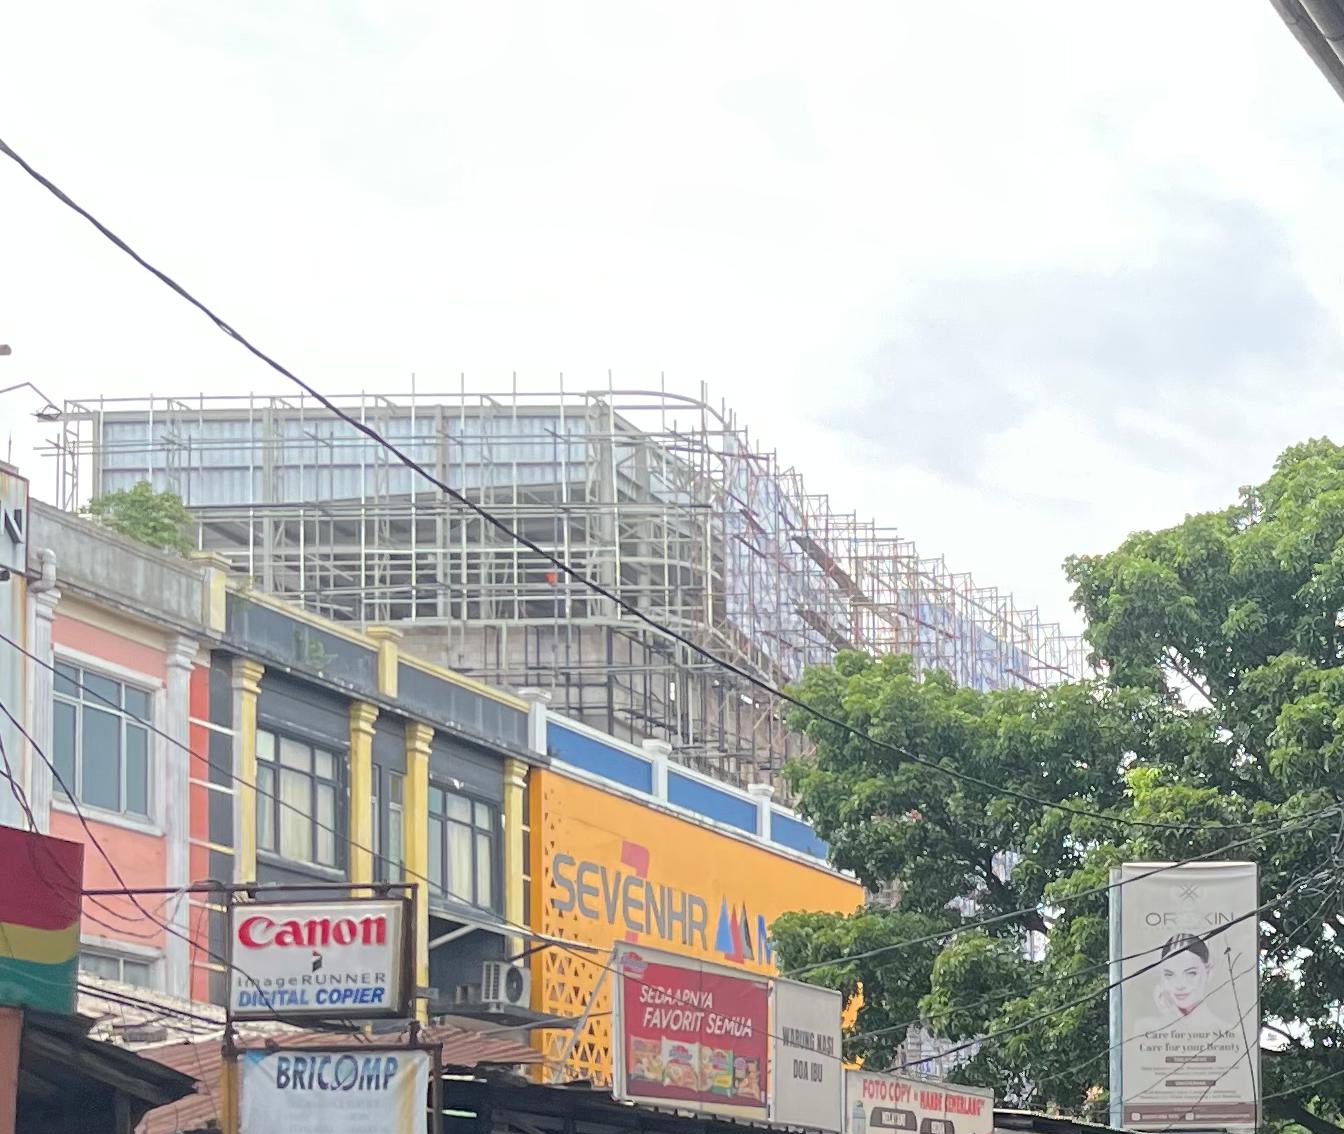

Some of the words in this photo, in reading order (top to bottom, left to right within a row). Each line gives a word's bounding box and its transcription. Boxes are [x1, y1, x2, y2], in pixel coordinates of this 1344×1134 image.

[1145, 911, 1234, 927] ORKIN
[238, 914, 386, 949] Canon
[237, 972, 386, 988] imageRUNNER
[238, 989, 309, 1008] DIGITAL
[316, 987, 385, 1005] COPIER
[639, 984, 713, 1009] SEDAAPNYA
[643, 1007, 704, 1033] FAVORIT
[706, 1013, 752, 1037] SEMUA
[782, 1026, 815, 1050] WARUNG
[817, 1033, 835, 1054] NASI
[1144, 1030, 1169, 1039] Care
[1170, 1030, 1186, 1039] for
[1188, 1031, 1210, 1041] your
[1139, 1043, 1164, 1052] Care
[1165, 1043, 1182, 1052] for
[1183, 1044, 1206, 1054] your
[1206, 1043, 1240, 1054] Beauty
[276, 1054, 399, 1091] BRICOMP
[793, 1059, 809, 1081] DOA
[811, 1063, 823, 1083] IBU
[862, 1078, 887, 1101] FOTO
[889, 1082, 912, 1104] COPY
